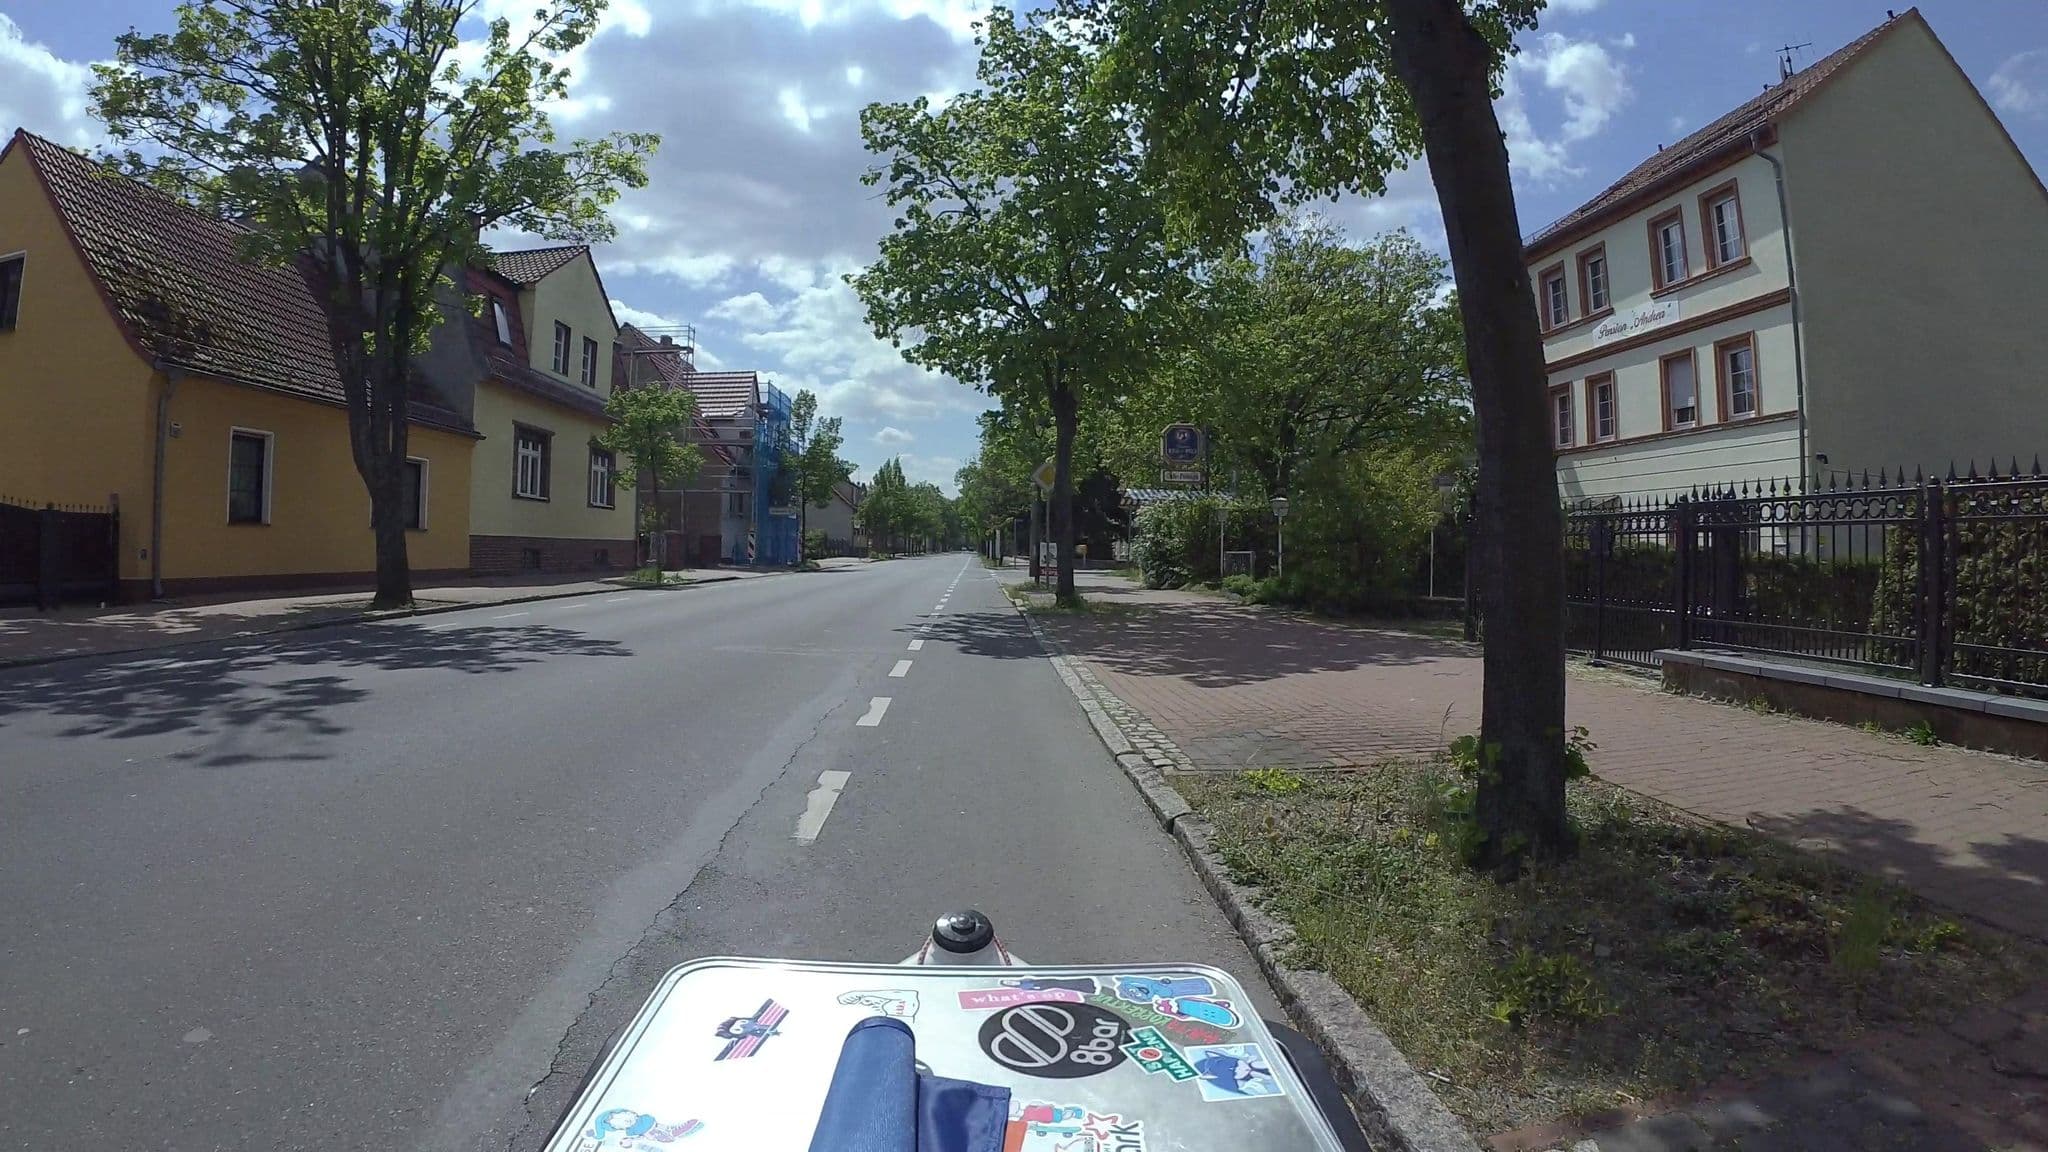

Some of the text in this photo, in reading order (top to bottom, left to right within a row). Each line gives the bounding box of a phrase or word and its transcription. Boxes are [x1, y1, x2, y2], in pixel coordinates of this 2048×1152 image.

[1599, 323, 1627, 338] Pension
[971, 991, 1066, 1003] what's up
[1070, 1018, 1120, 1065] 8bar
